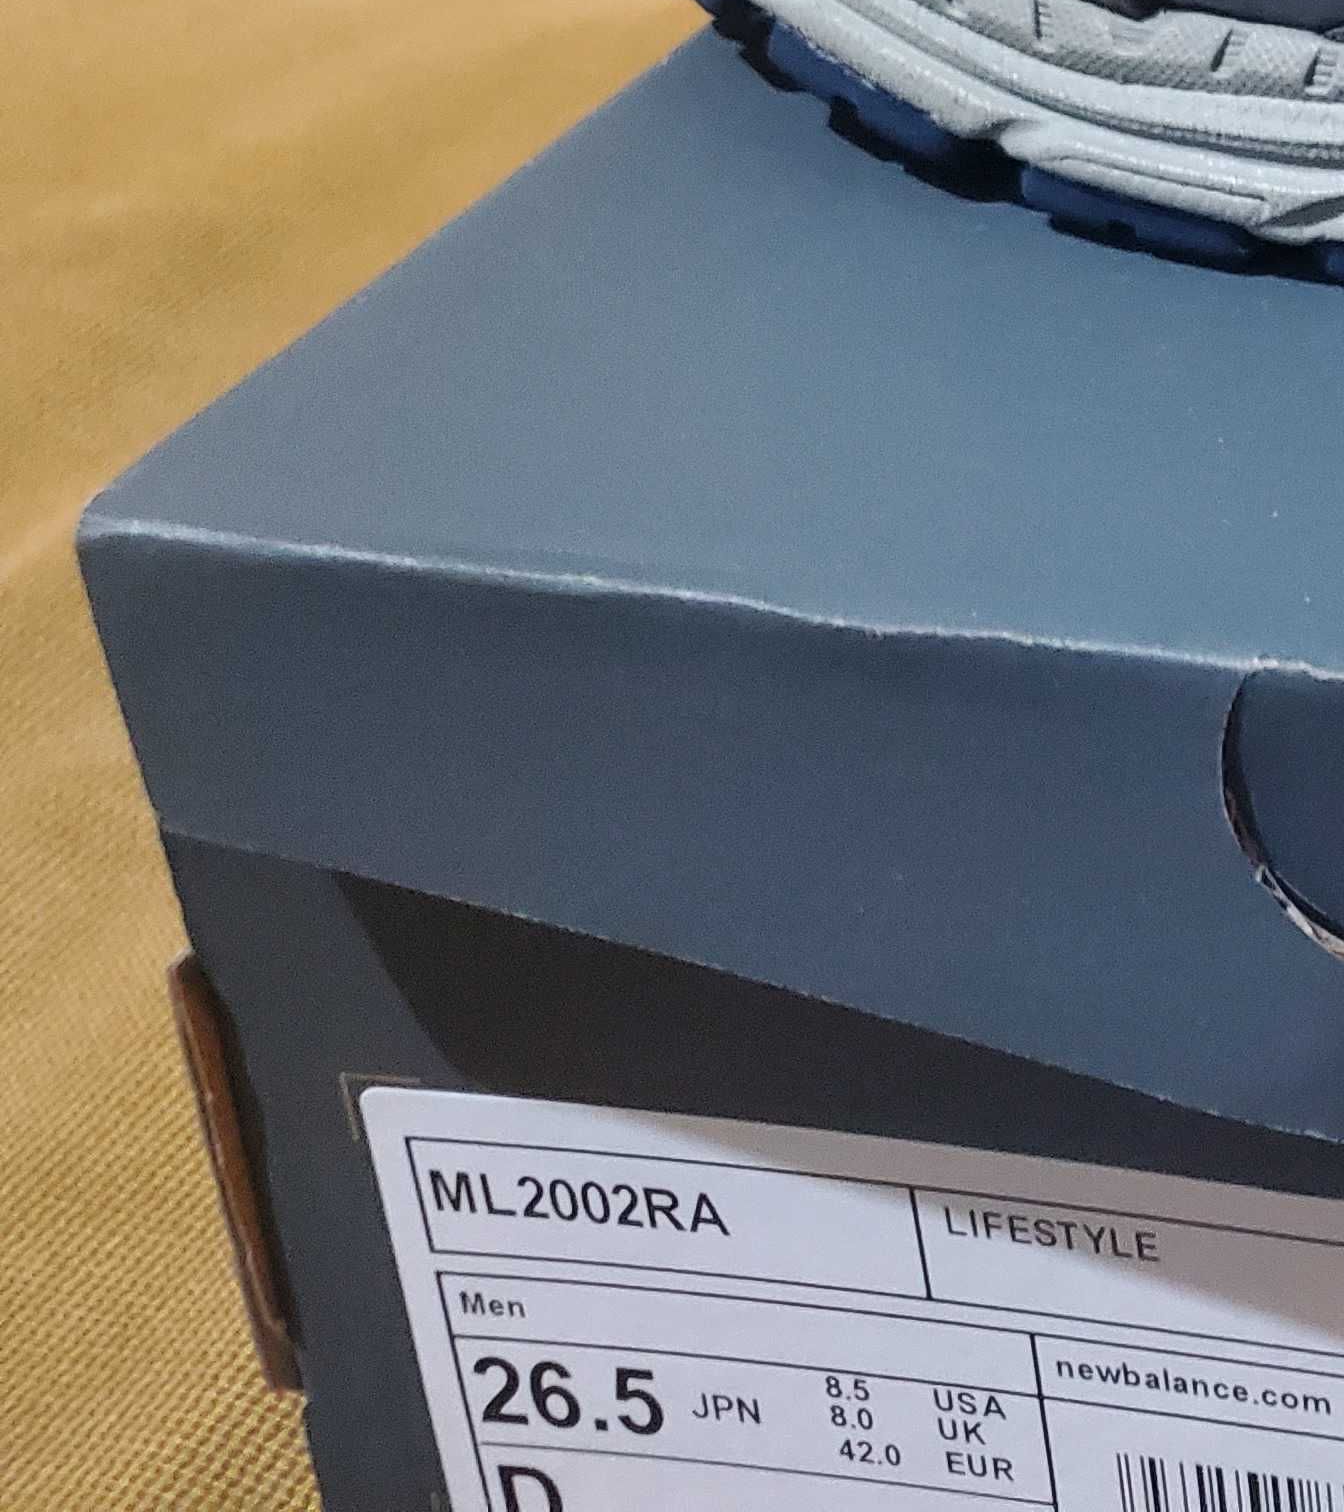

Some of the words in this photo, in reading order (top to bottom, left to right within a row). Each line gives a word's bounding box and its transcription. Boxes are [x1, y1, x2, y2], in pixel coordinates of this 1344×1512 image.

[429, 1170, 731, 1236] ML2002RA
[944, 1206, 1162, 1263] LIFESTYLE
[459, 1291, 526, 1319] Men
[472, 1356, 664, 1436] 26.5
[692, 1395, 762, 1425] JPN
[825, 1376, 870, 1401] 8.5
[933, 1388, 1006, 1420] USA
[1055, 1356, 1333, 1416] newbalance.com
[830, 1405, 873, 1430] 8.0
[937, 1418, 986, 1445] UK
[839, 1439, 901, 1466] 42.0
[946, 1451, 1014, 1481] EUR
